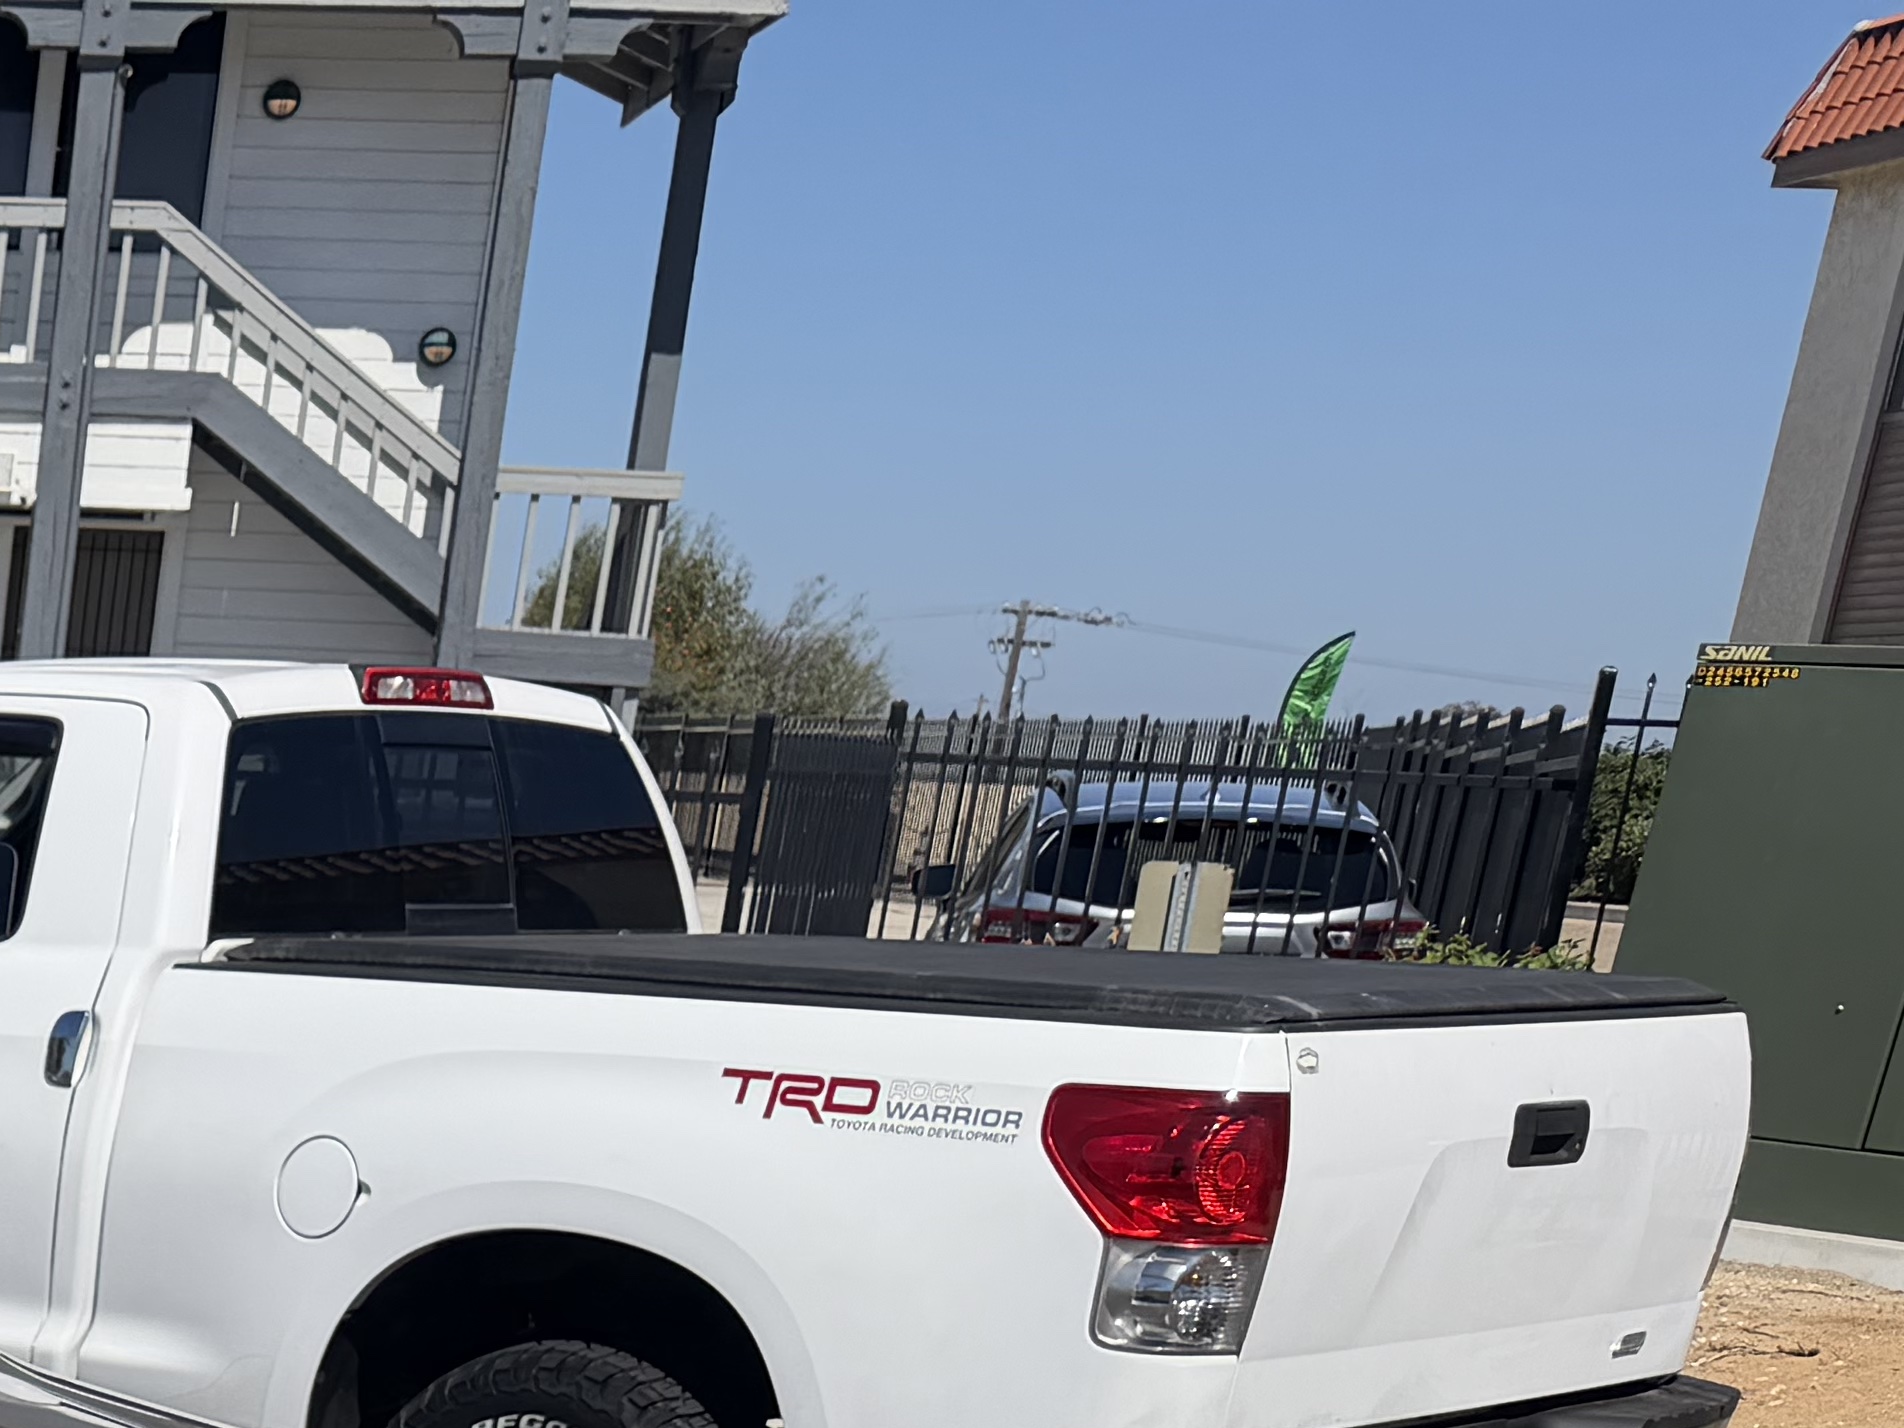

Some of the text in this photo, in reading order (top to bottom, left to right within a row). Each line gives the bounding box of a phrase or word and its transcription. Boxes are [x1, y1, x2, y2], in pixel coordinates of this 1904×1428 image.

[721, 1067, 973, 1125] TRD ROCK
[886, 1101, 1024, 1129] WARRIOR
[830, 1118, 1019, 1145] TOYOTA RACING DEVELOPMENT
